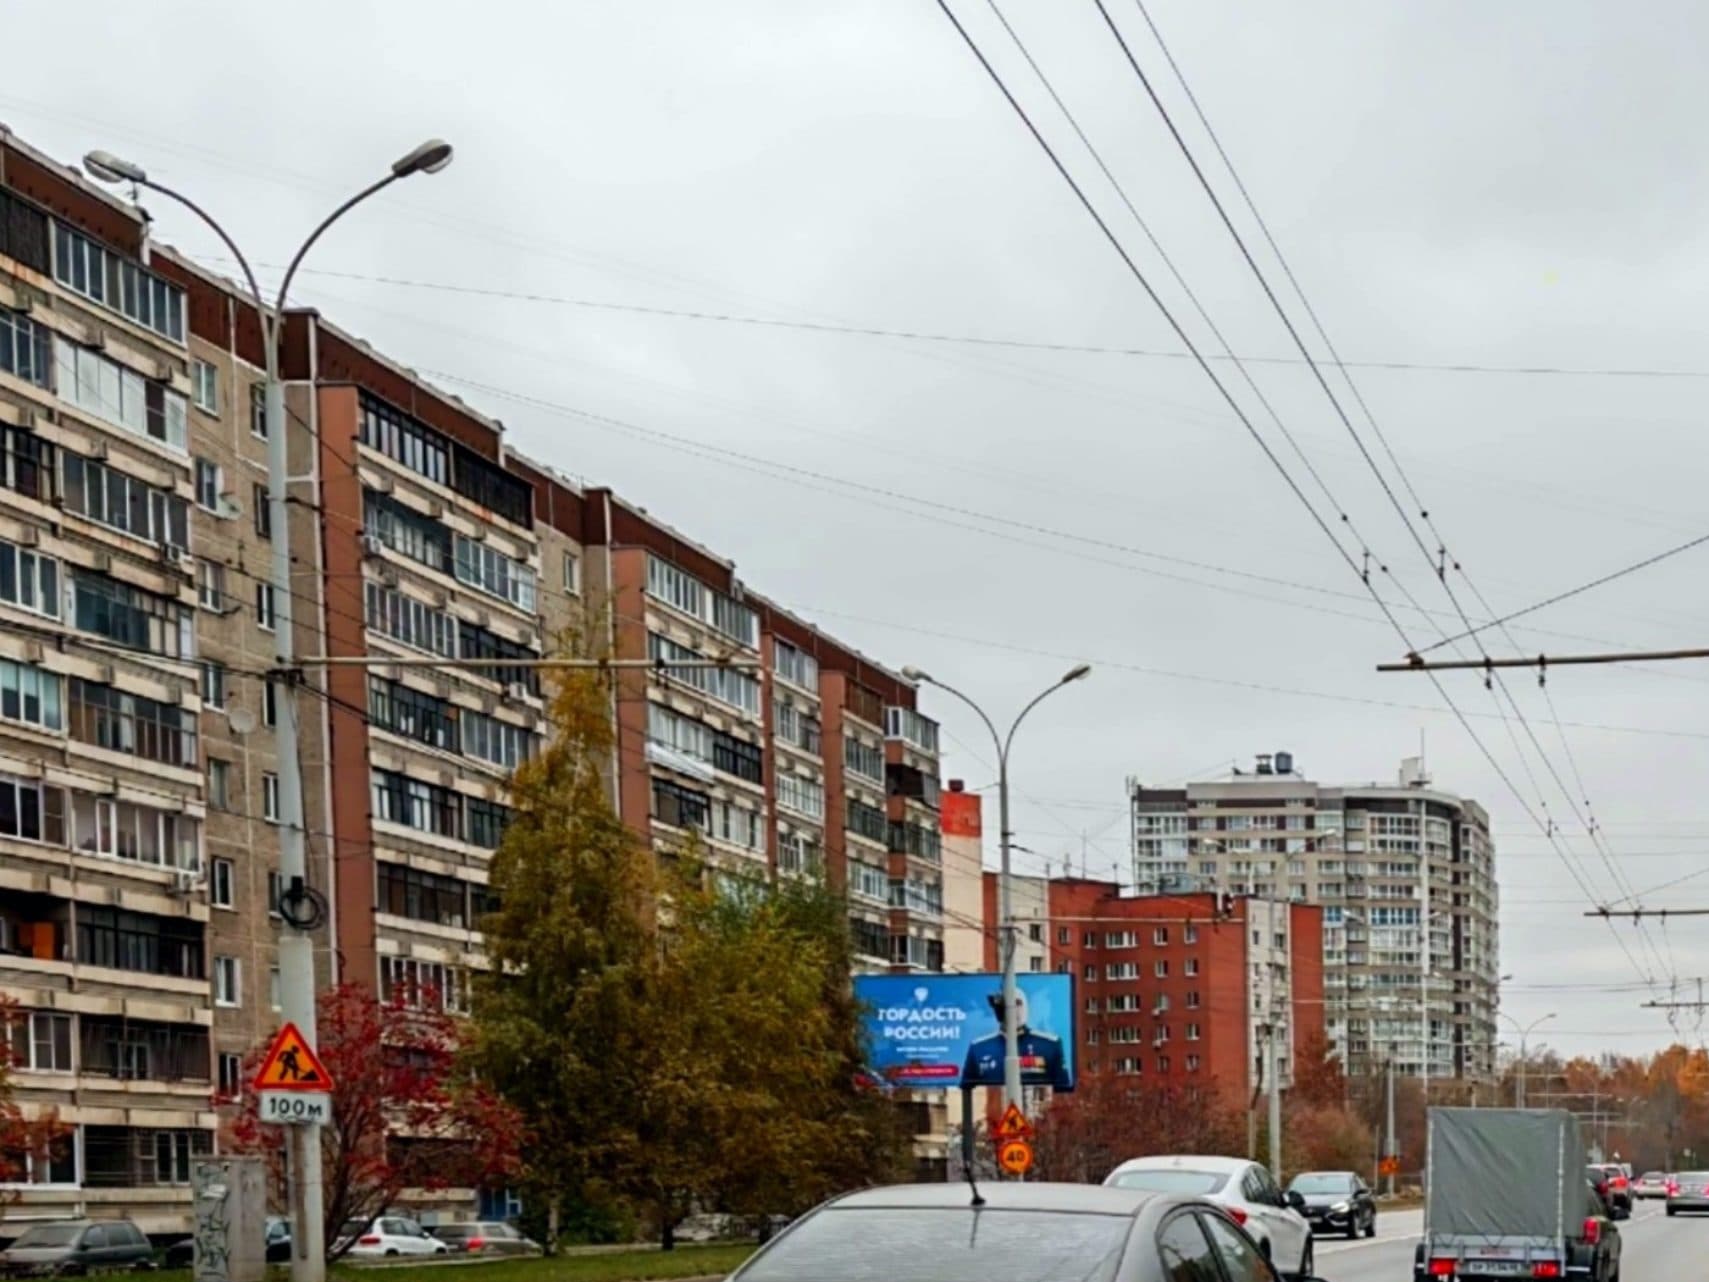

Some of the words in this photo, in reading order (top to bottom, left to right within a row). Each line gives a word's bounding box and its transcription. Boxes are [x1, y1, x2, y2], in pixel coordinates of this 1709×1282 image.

[878, 1007, 967, 1022] ГОРДОСТЬ
[883, 1026, 960, 1040] РОССИИ!
[1006, 1150, 1026, 1162] 40
